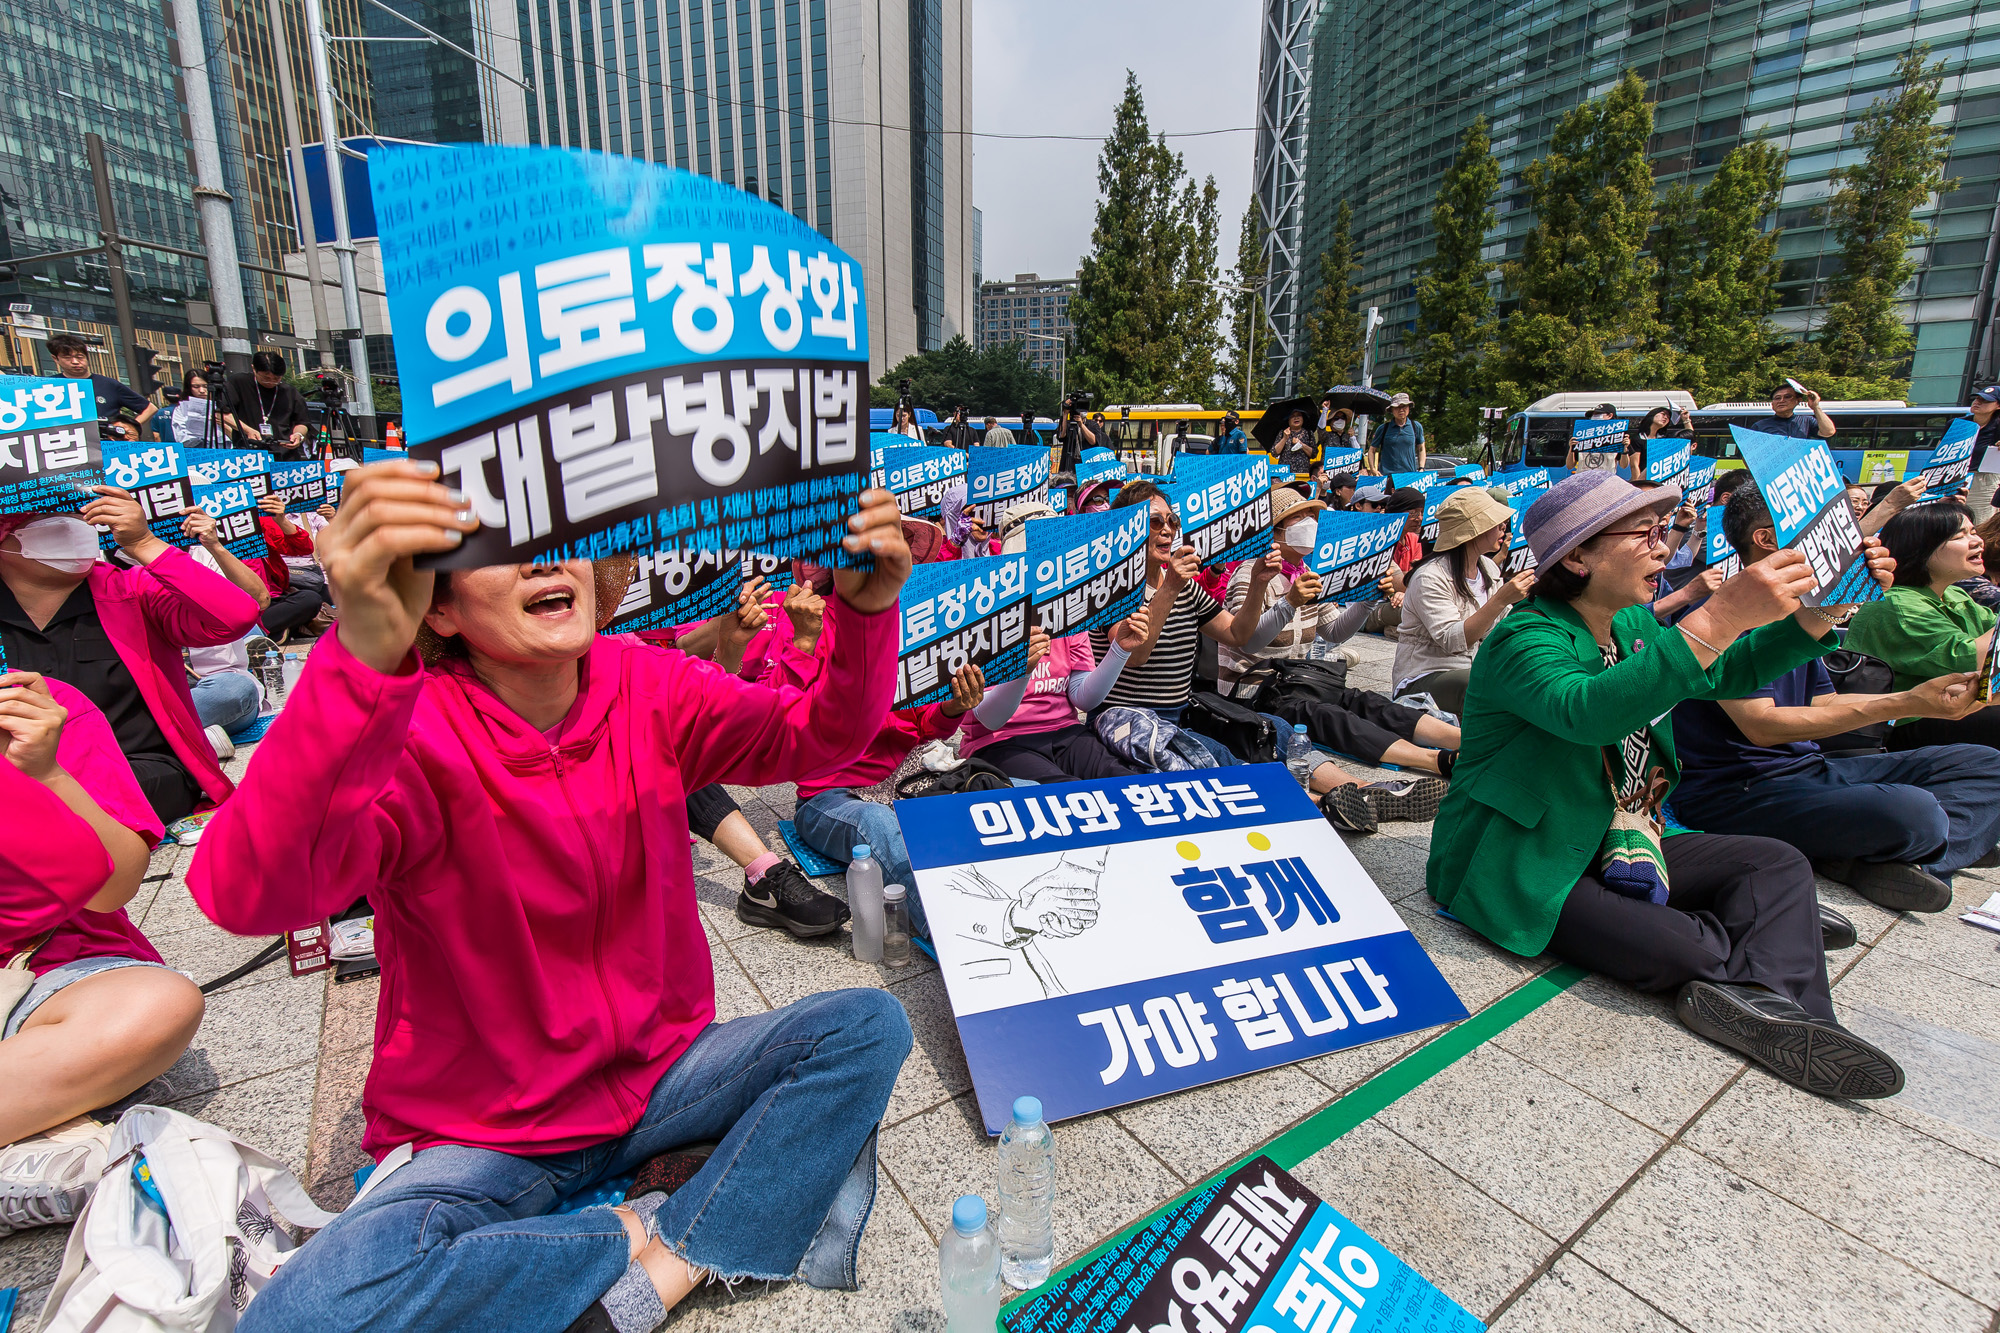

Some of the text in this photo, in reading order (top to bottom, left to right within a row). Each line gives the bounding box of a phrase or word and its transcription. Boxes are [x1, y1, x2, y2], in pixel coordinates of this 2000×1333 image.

[425, 242, 859, 408] 의료정상화
[0, 382, 85, 431] 상화
[1573, 432, 1625, 452] 재발방지법
[1576, 420, 1627, 439] 의료정상화
[0, 427, 88, 474] 지법
[105, 446, 179, 487] 상화
[441, 368, 857, 547] 재발방지법
[272, 462, 322, 488] 정상화
[890, 451, 964, 491] 의료정상화
[973, 450, 1049, 499] 의료정상화
[1506, 469, 1548, 495] 료정상화
[1766, 445, 1840, 532] 의료정상화
[199, 484, 249, 518] 상화
[275, 480, 325, 505] 방지법
[1186, 458, 1268, 524] 의료정상화
[574, 513, 654, 562] 집단휴진
[657, 501, 697, 539] 철회
[701, 495, 719, 526] 및
[722, 490, 752, 520] 재발
[754, 483, 788, 516] 방지법
[726, 517, 767, 549] 방지법
[1190, 493, 1271, 560] 재발방지법
[1036, 504, 1148, 595] 의료정상화
[1317, 516, 1405, 569] 의료정상화
[650, 608, 666, 625] 철회
[677, 598, 691, 612] 재발
[692, 587, 710, 605] 방지법
[1037, 543, 1147, 634] 재발방지법
[677, 606, 698, 625] 방지법
[1031, 661, 1051, 680] NK
[969, 778, 1266, 846] 의사와 환자는
[1170, 855, 1341, 944] 함께
[1077, 957, 1399, 1086] 가야 합니다
[1184, 1189, 1215, 1223] 집단휴진
[1163, 1234, 1178, 1251] 및
[1171, 1217, 1191, 1241] 철회
[1129, 1232, 1157, 1264] 방지법
[1149, 1245, 1169, 1270] 재발
[1114, 1257, 1135, 1283] 제정
[1127, 1263, 1156, 1299] 방지법
[1247, 1222, 1380, 1333] 의료
[1045, 1307, 1067, 1333] 의사
[1093, 1311, 1116, 1333] 환자
[1111, 1292, 1133, 1319] 제정
